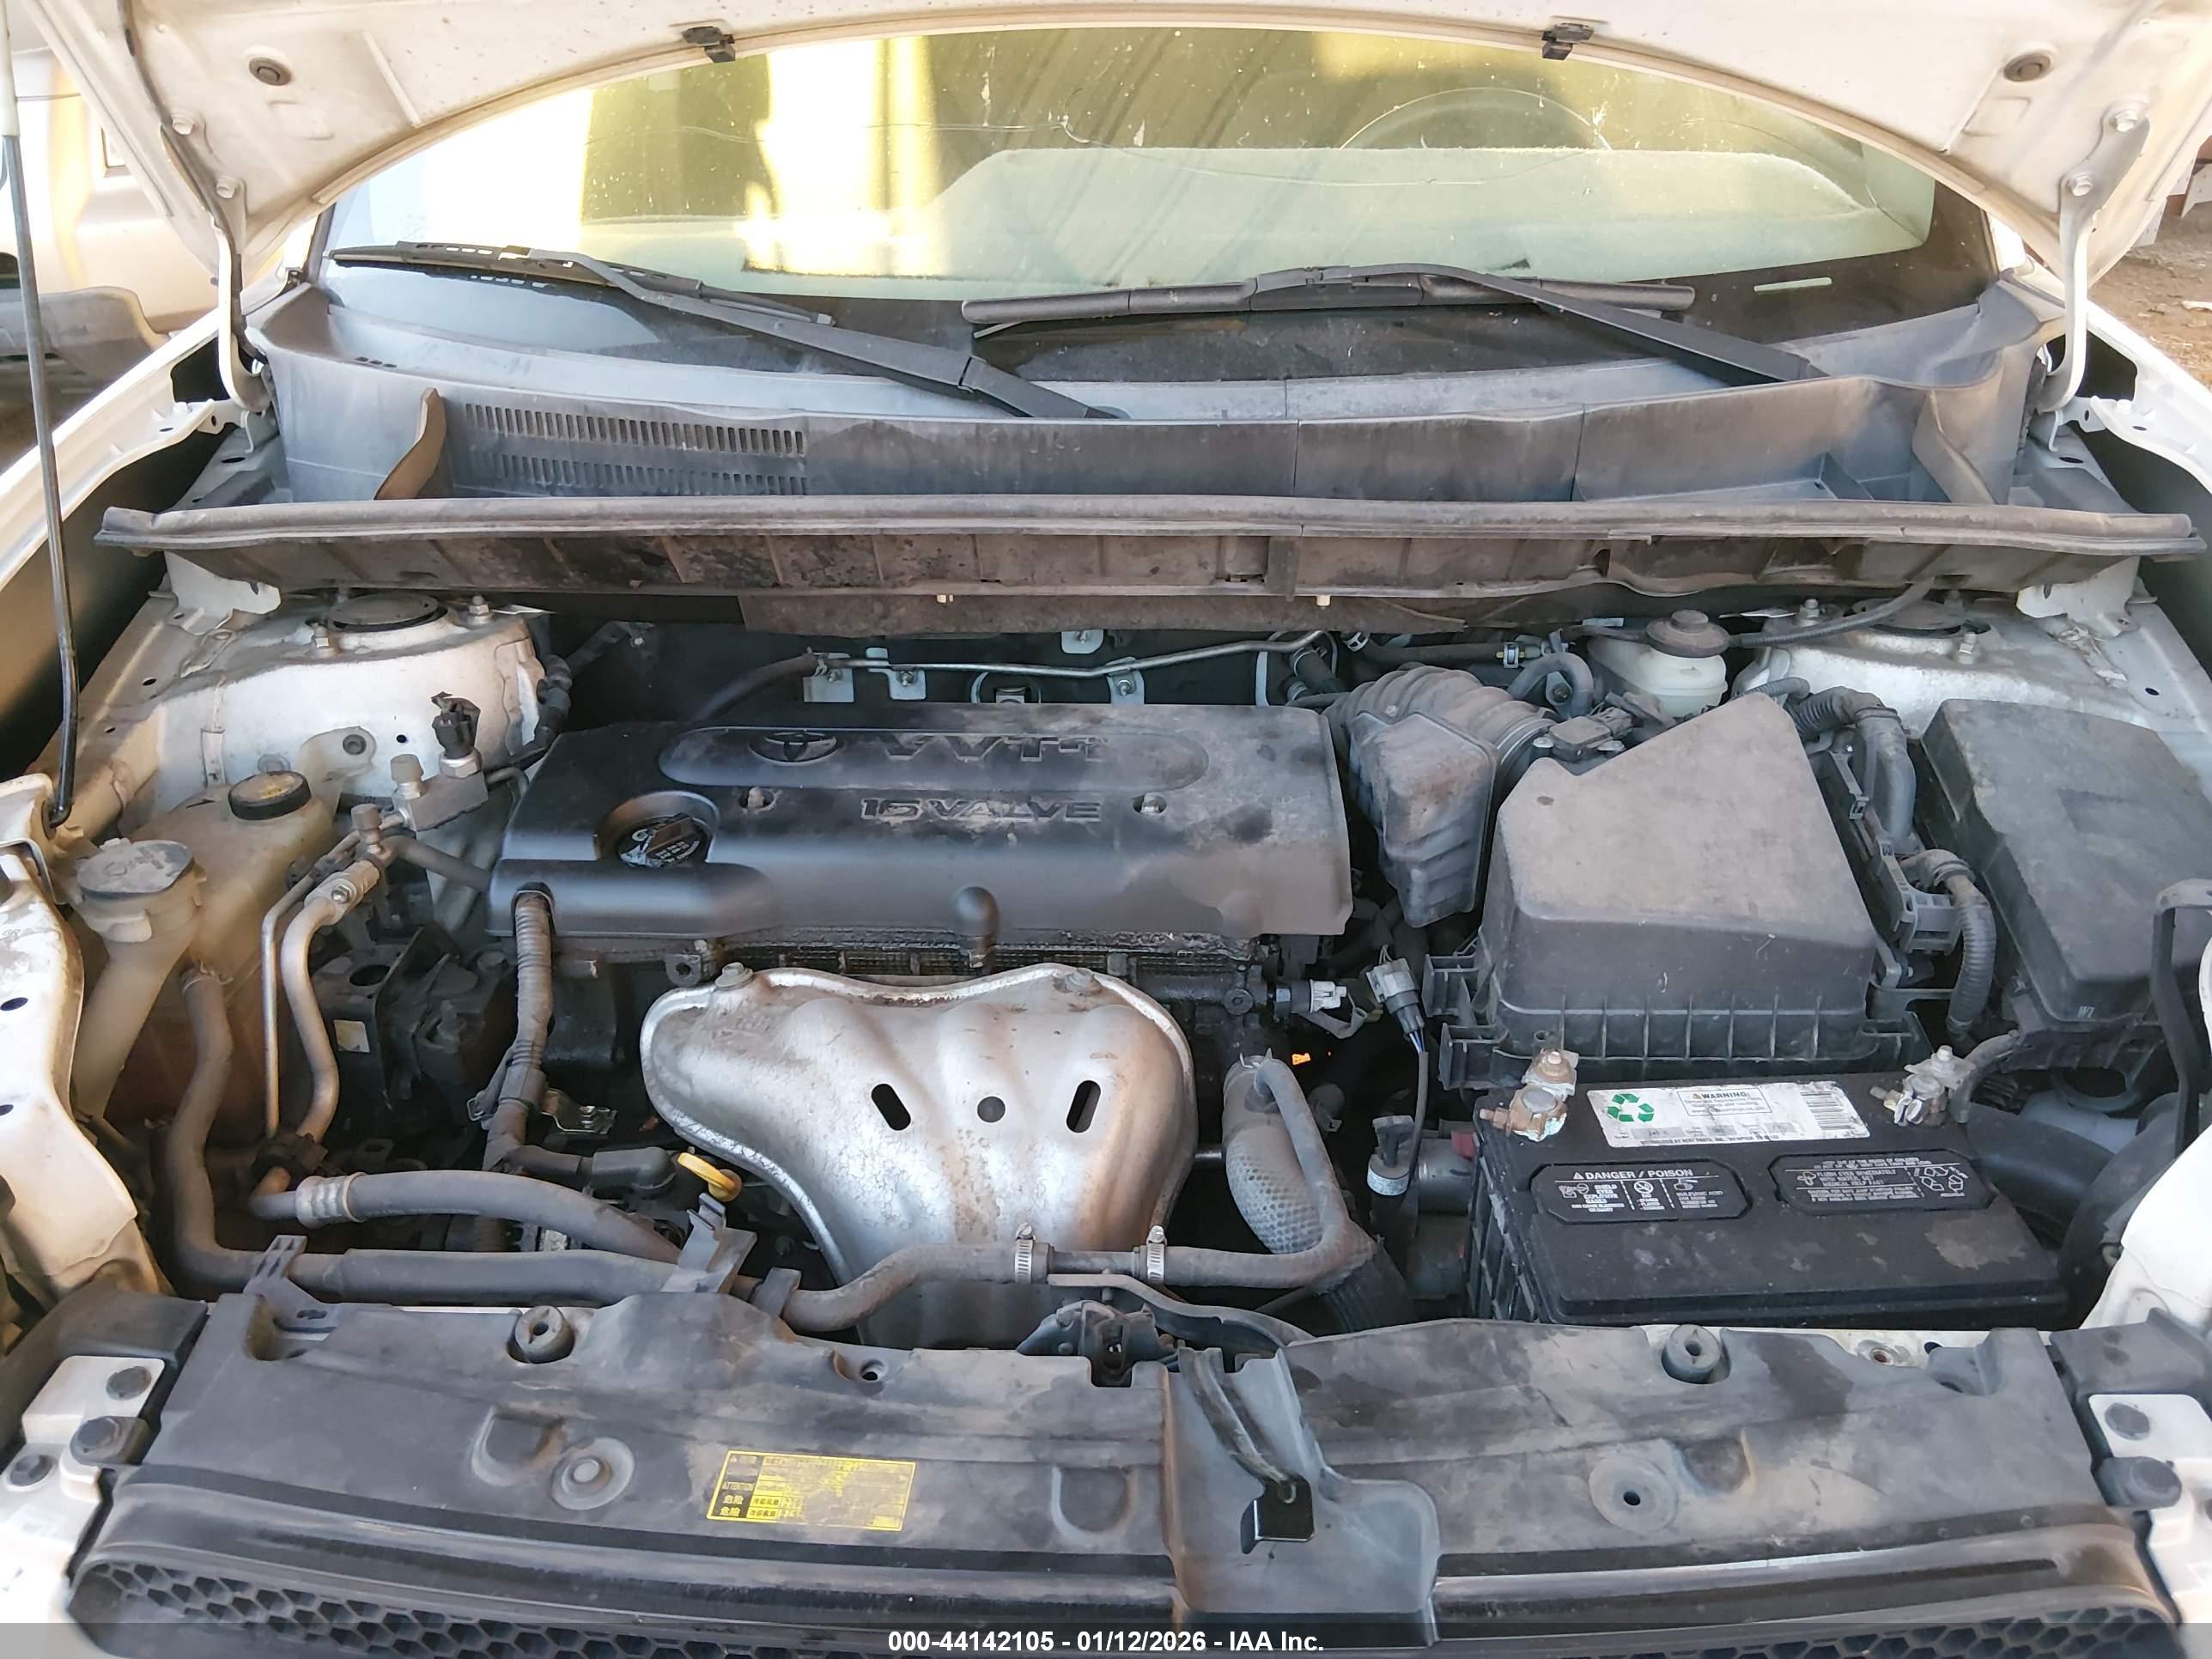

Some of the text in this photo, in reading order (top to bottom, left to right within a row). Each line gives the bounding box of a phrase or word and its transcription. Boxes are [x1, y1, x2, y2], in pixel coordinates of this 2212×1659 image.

[860, 797, 1103, 823] 16 VALVE
[1585, 1170, 1637, 1180] DANGER
[1648, 1169, 1694, 1177] POISON
